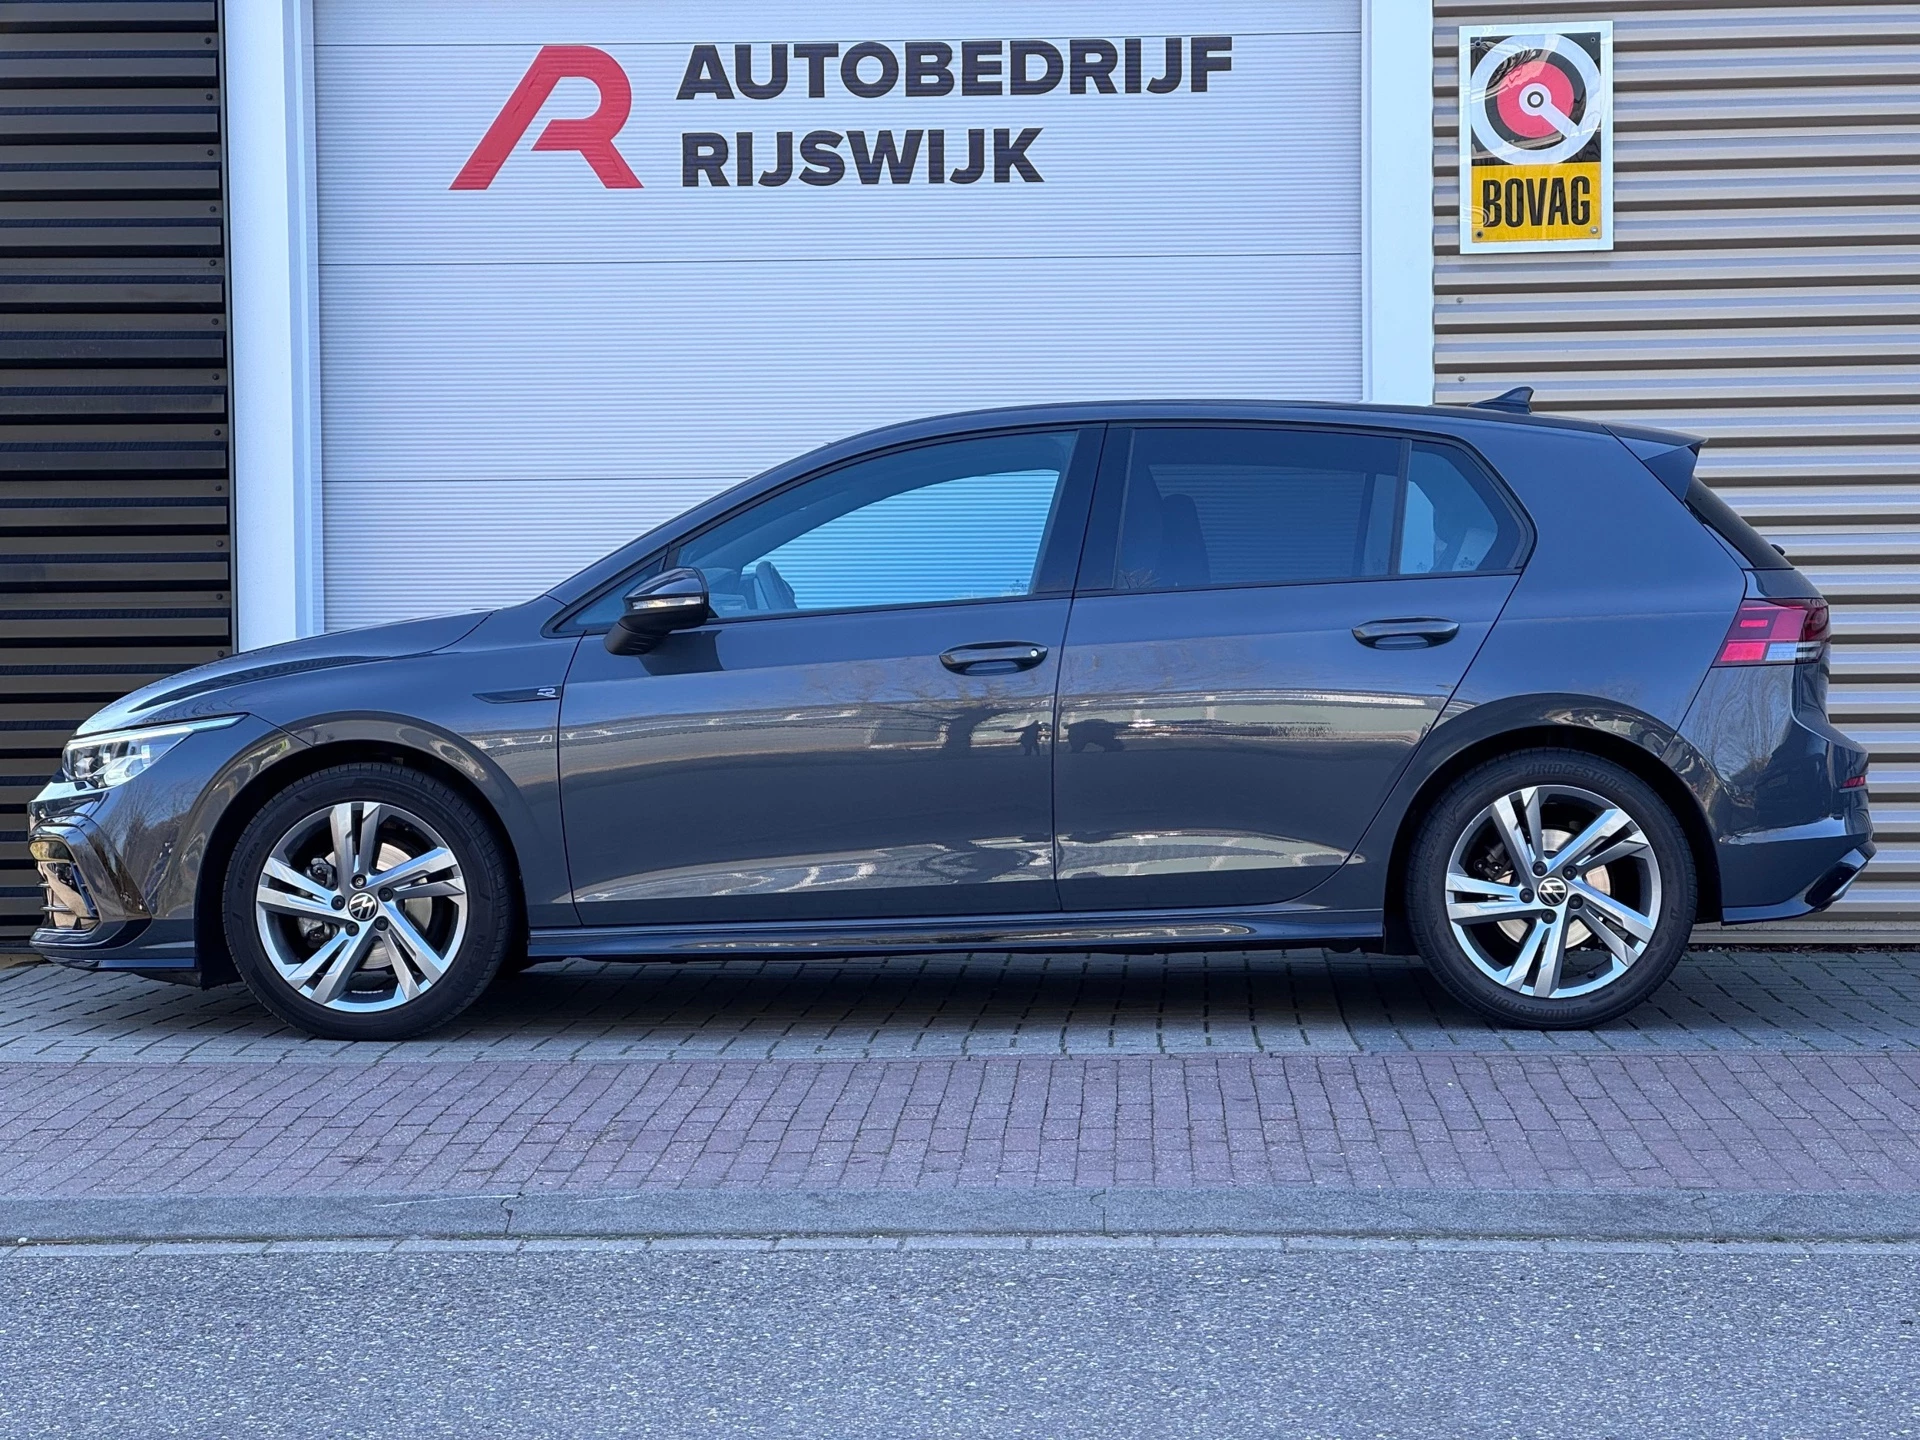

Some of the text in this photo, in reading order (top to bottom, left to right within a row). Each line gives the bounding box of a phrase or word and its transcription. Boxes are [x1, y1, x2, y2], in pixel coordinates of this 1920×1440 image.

[677, 37, 1232, 100] AUTOBEDRIJF
[682, 128, 1044, 188] RIJSWIJK
[1482, 176, 1591, 228] BOVAG
[1525, 763, 1627, 792] BRIDGESTONE
